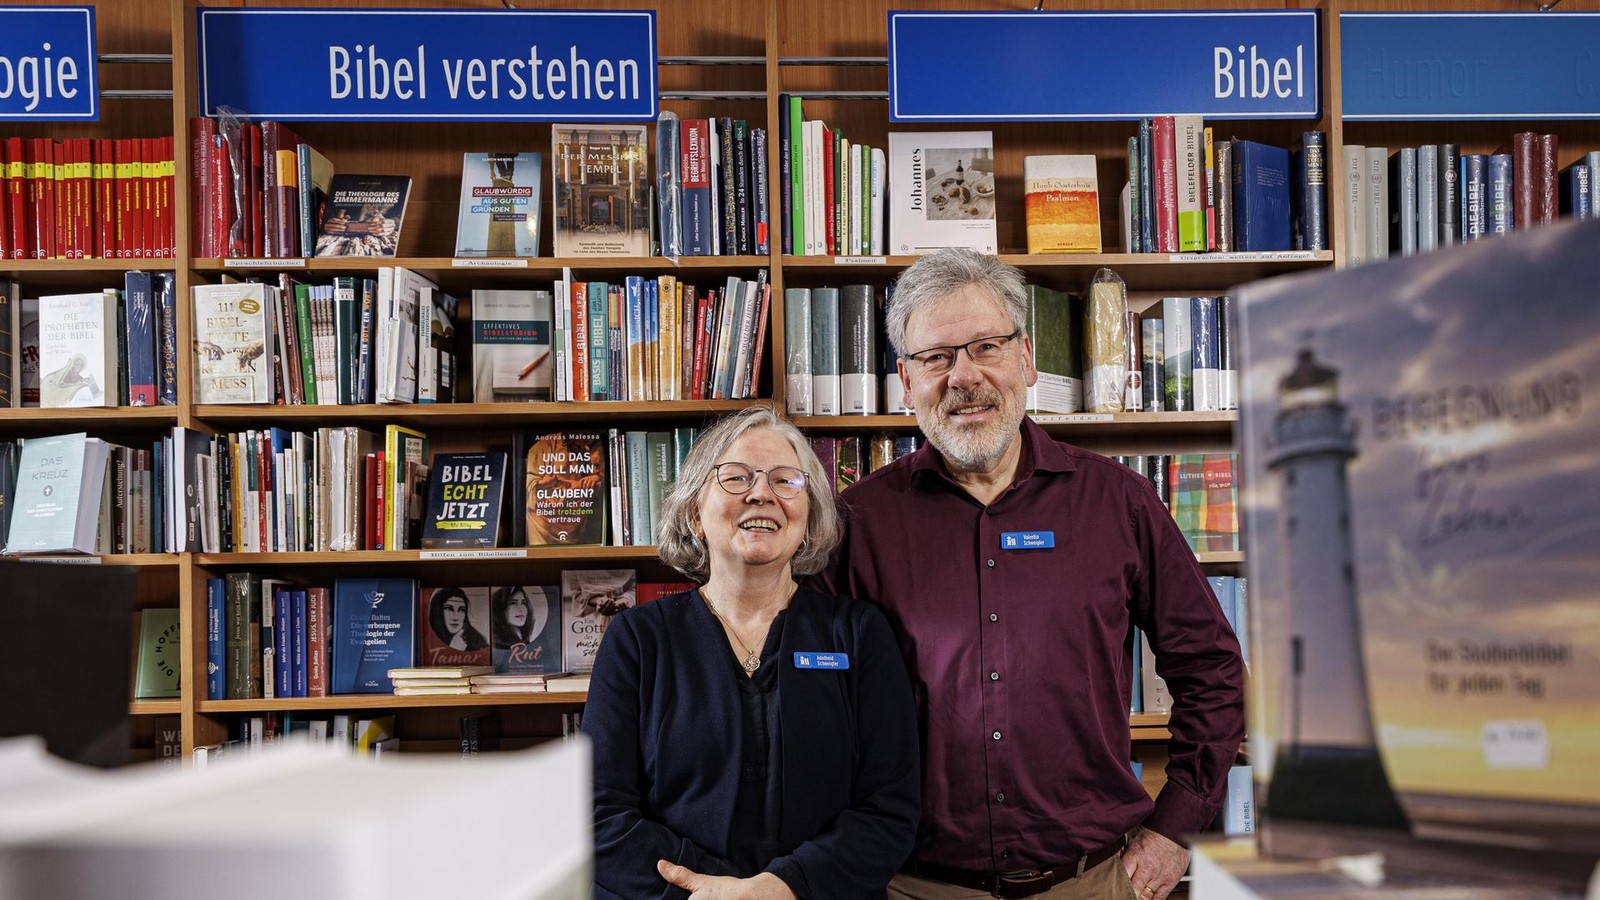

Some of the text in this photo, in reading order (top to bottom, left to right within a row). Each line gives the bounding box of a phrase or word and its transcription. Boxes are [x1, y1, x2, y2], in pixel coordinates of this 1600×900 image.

[329, 45, 639, 99] Bibel verstehen
[1214, 45, 1303, 98] Bibel
[689, 127, 700, 183] BEGRIFFSLEXIKON
[736, 150, 744, 166] durch
[579, 163, 622, 174] TEMPEL
[1186, 124, 1196, 203] BIELEFELDER BIBEL
[910, 147, 923, 212] Johannes
[1032, 180, 1092, 190] Huub Oosterhuis
[1579, 167, 1588, 194] BIBEL
[473, 187, 531, 196] GLAUBWÜRDIG
[738, 188, 745, 198] 24
[1045, 193, 1080, 202] Psalmen
[1351, 183, 1359, 204] BIBEL
[333, 196, 399, 204] ZIMMERMANNS
[482, 197, 527, 205] AUS GUTEN
[1469, 176, 1479, 234] DIE BIBEL
[1495, 176, 1505, 233] DIE BIBEL
[472, 205, 511, 213] GRÜNDEN
[218, 302, 234, 313] 111
[63, 312, 80, 321] DIE
[577, 311, 583, 319] IM
[44, 321, 99, 332] PROPHETEN
[741, 332, 749, 355] SCHATZ
[745, 299, 753, 319] ZEITEN
[47, 331, 96, 342] DER BIBEL
[361, 323, 369, 343] GOTT.
[576, 320, 584, 350] BIBEL
[592, 315, 604, 386] BASIS BIBEL
[164, 370, 174, 384] 42
[211, 378, 247, 390] MUSS
[40, 456, 64, 467] DAS
[542, 452, 591, 463] UND DAS
[31, 469, 69, 481] KREUZ
[441, 464, 493, 484] BIBEL
[538, 464, 595, 475] SOLL MAN
[116, 459, 125, 509] Auferstehung?
[443, 484, 488, 501] ECHT
[536, 488, 595, 500] GLAUBEN?
[536, 500, 594, 509] Warum ich der
[436, 502, 490, 521] JETZT
[536, 508, 556, 516] Bibel
[547, 516, 581, 524] vertraue
[363, 622, 401, 630] verborgene
[571, 620, 605, 634] Gott
[350, 630, 383, 638] Theologie
[350, 638, 387, 646] Evangelien
[576, 638, 599, 648] mich
[429, 646, 483, 665] Tamar
[508, 642, 543, 664] Rut
[156, 660, 174, 677] DIE
